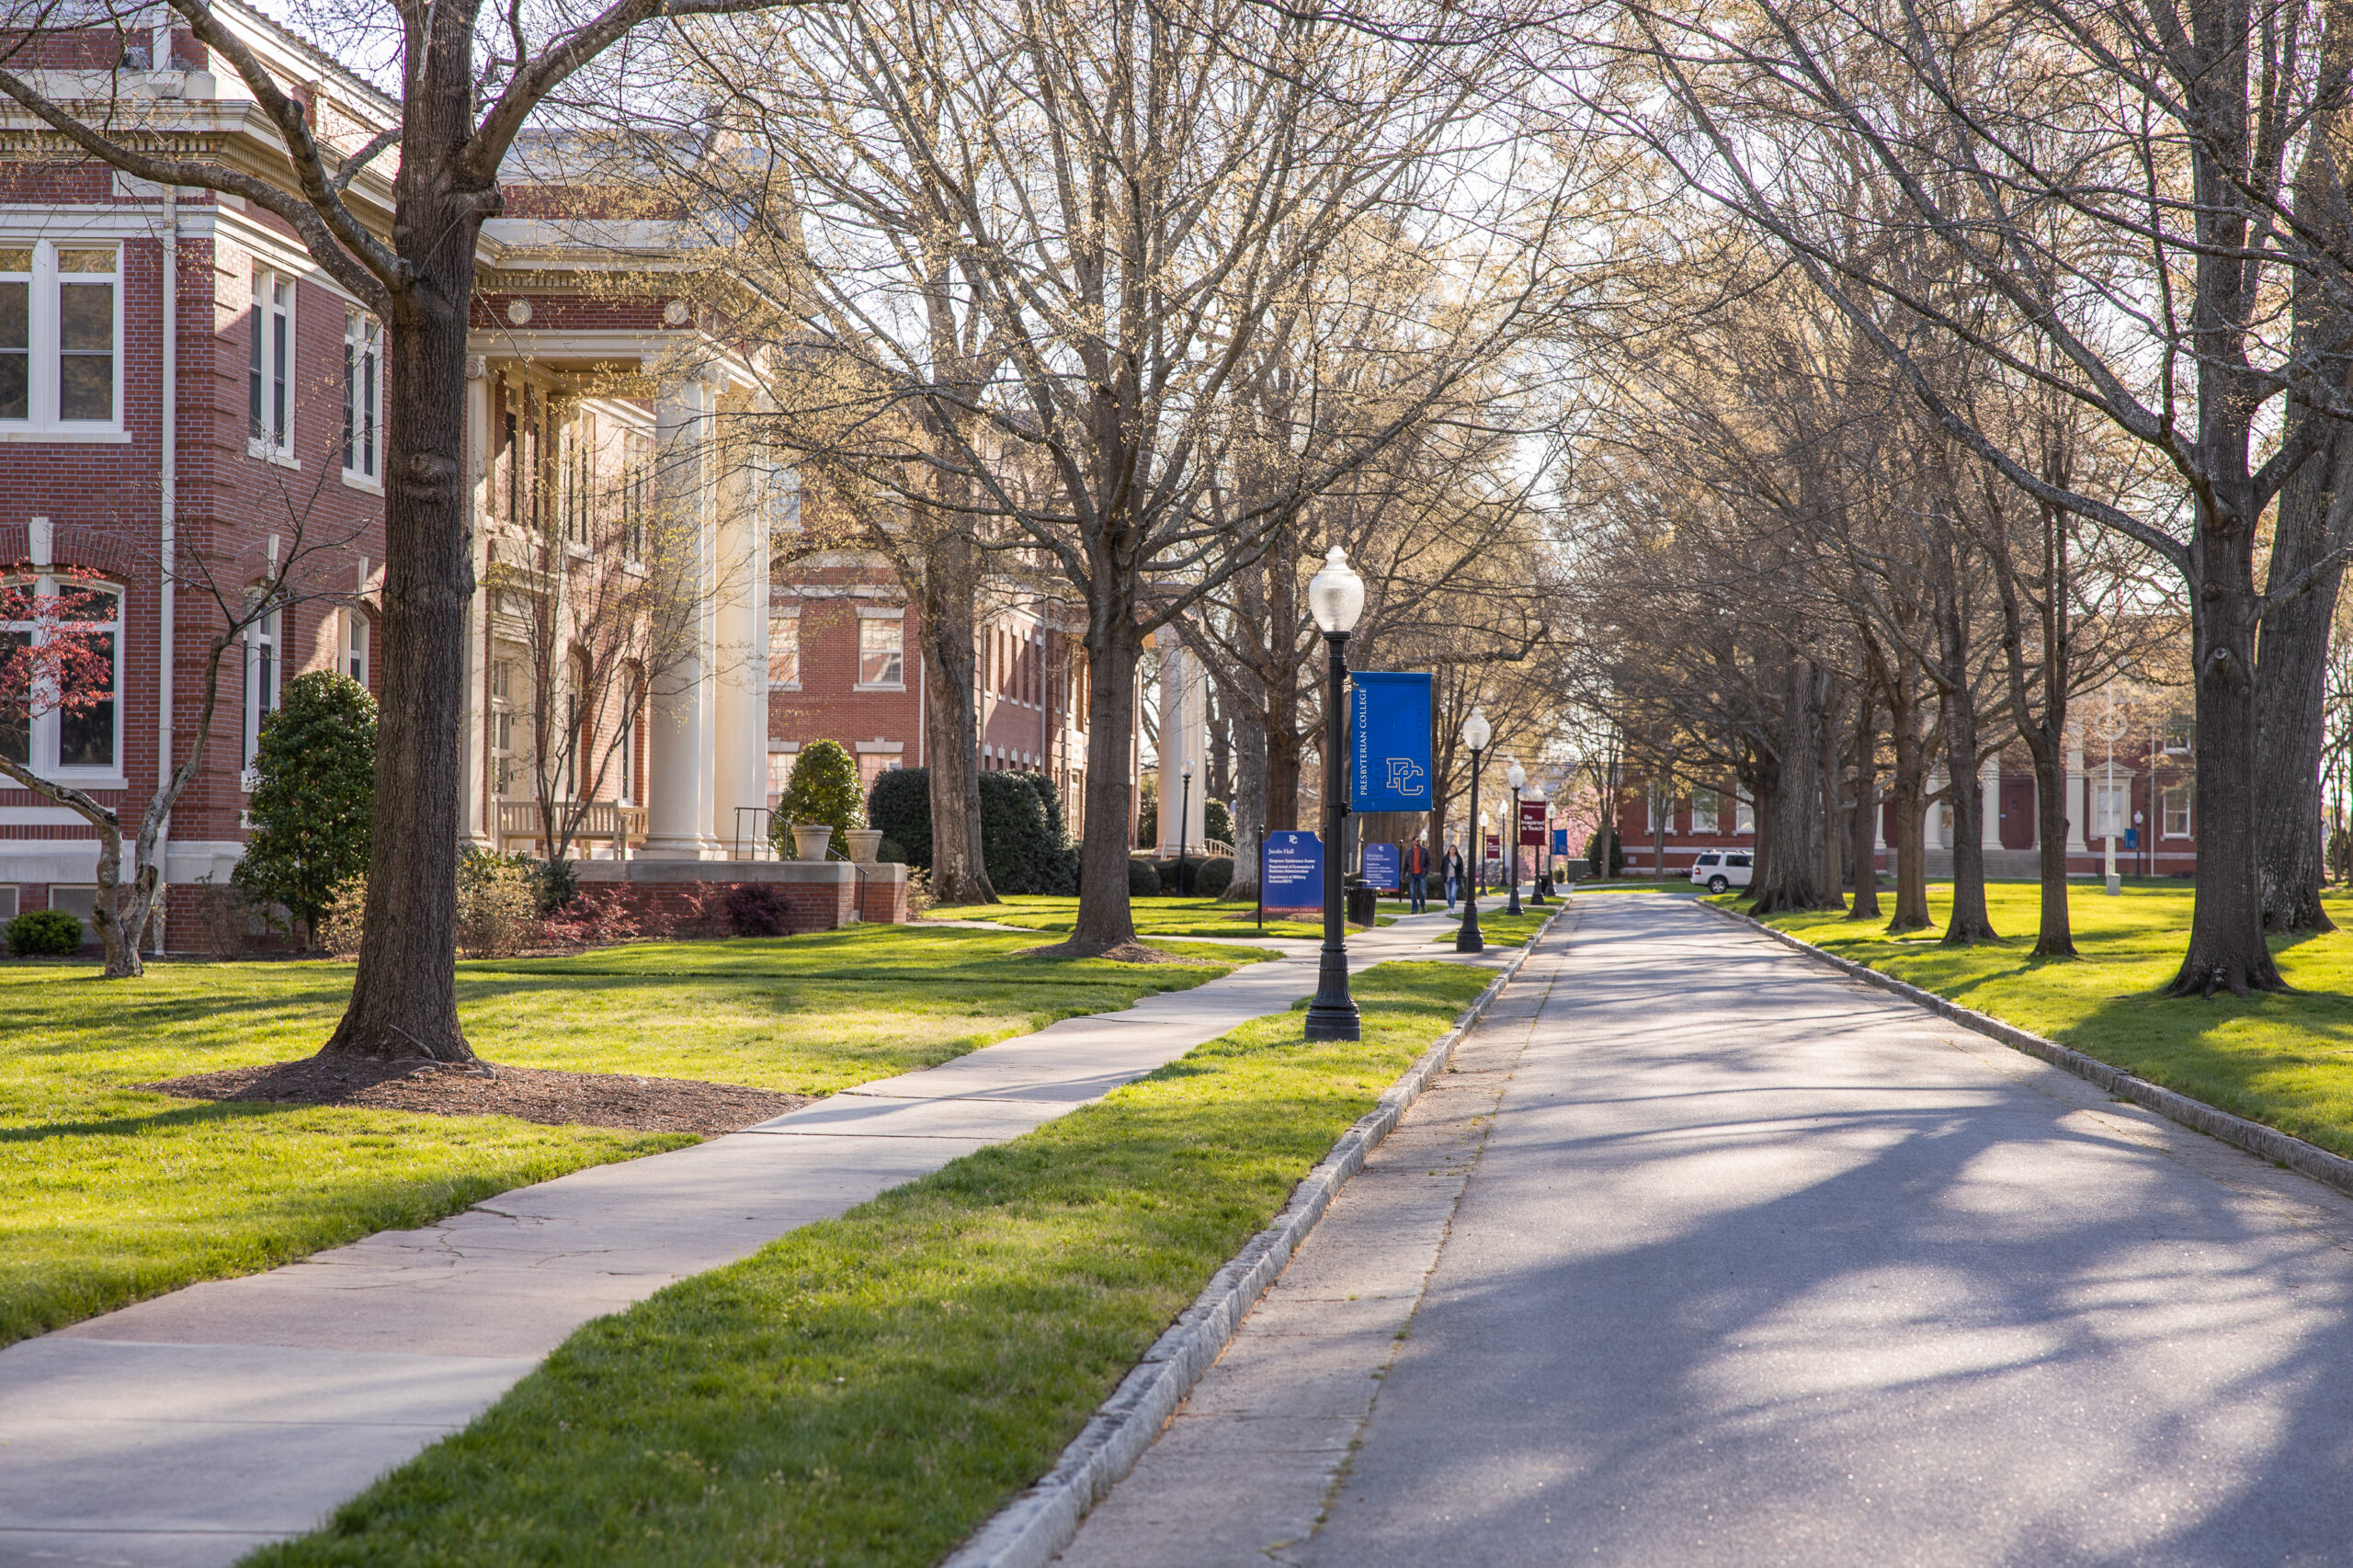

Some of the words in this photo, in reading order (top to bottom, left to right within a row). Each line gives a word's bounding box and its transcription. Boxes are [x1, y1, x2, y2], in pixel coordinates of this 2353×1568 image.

[1358, 687, 1367, 729] COLLEGE
[1359, 731, 1368, 796] PRESBYTERIAN
[1386, 757, 1424, 796] PC
